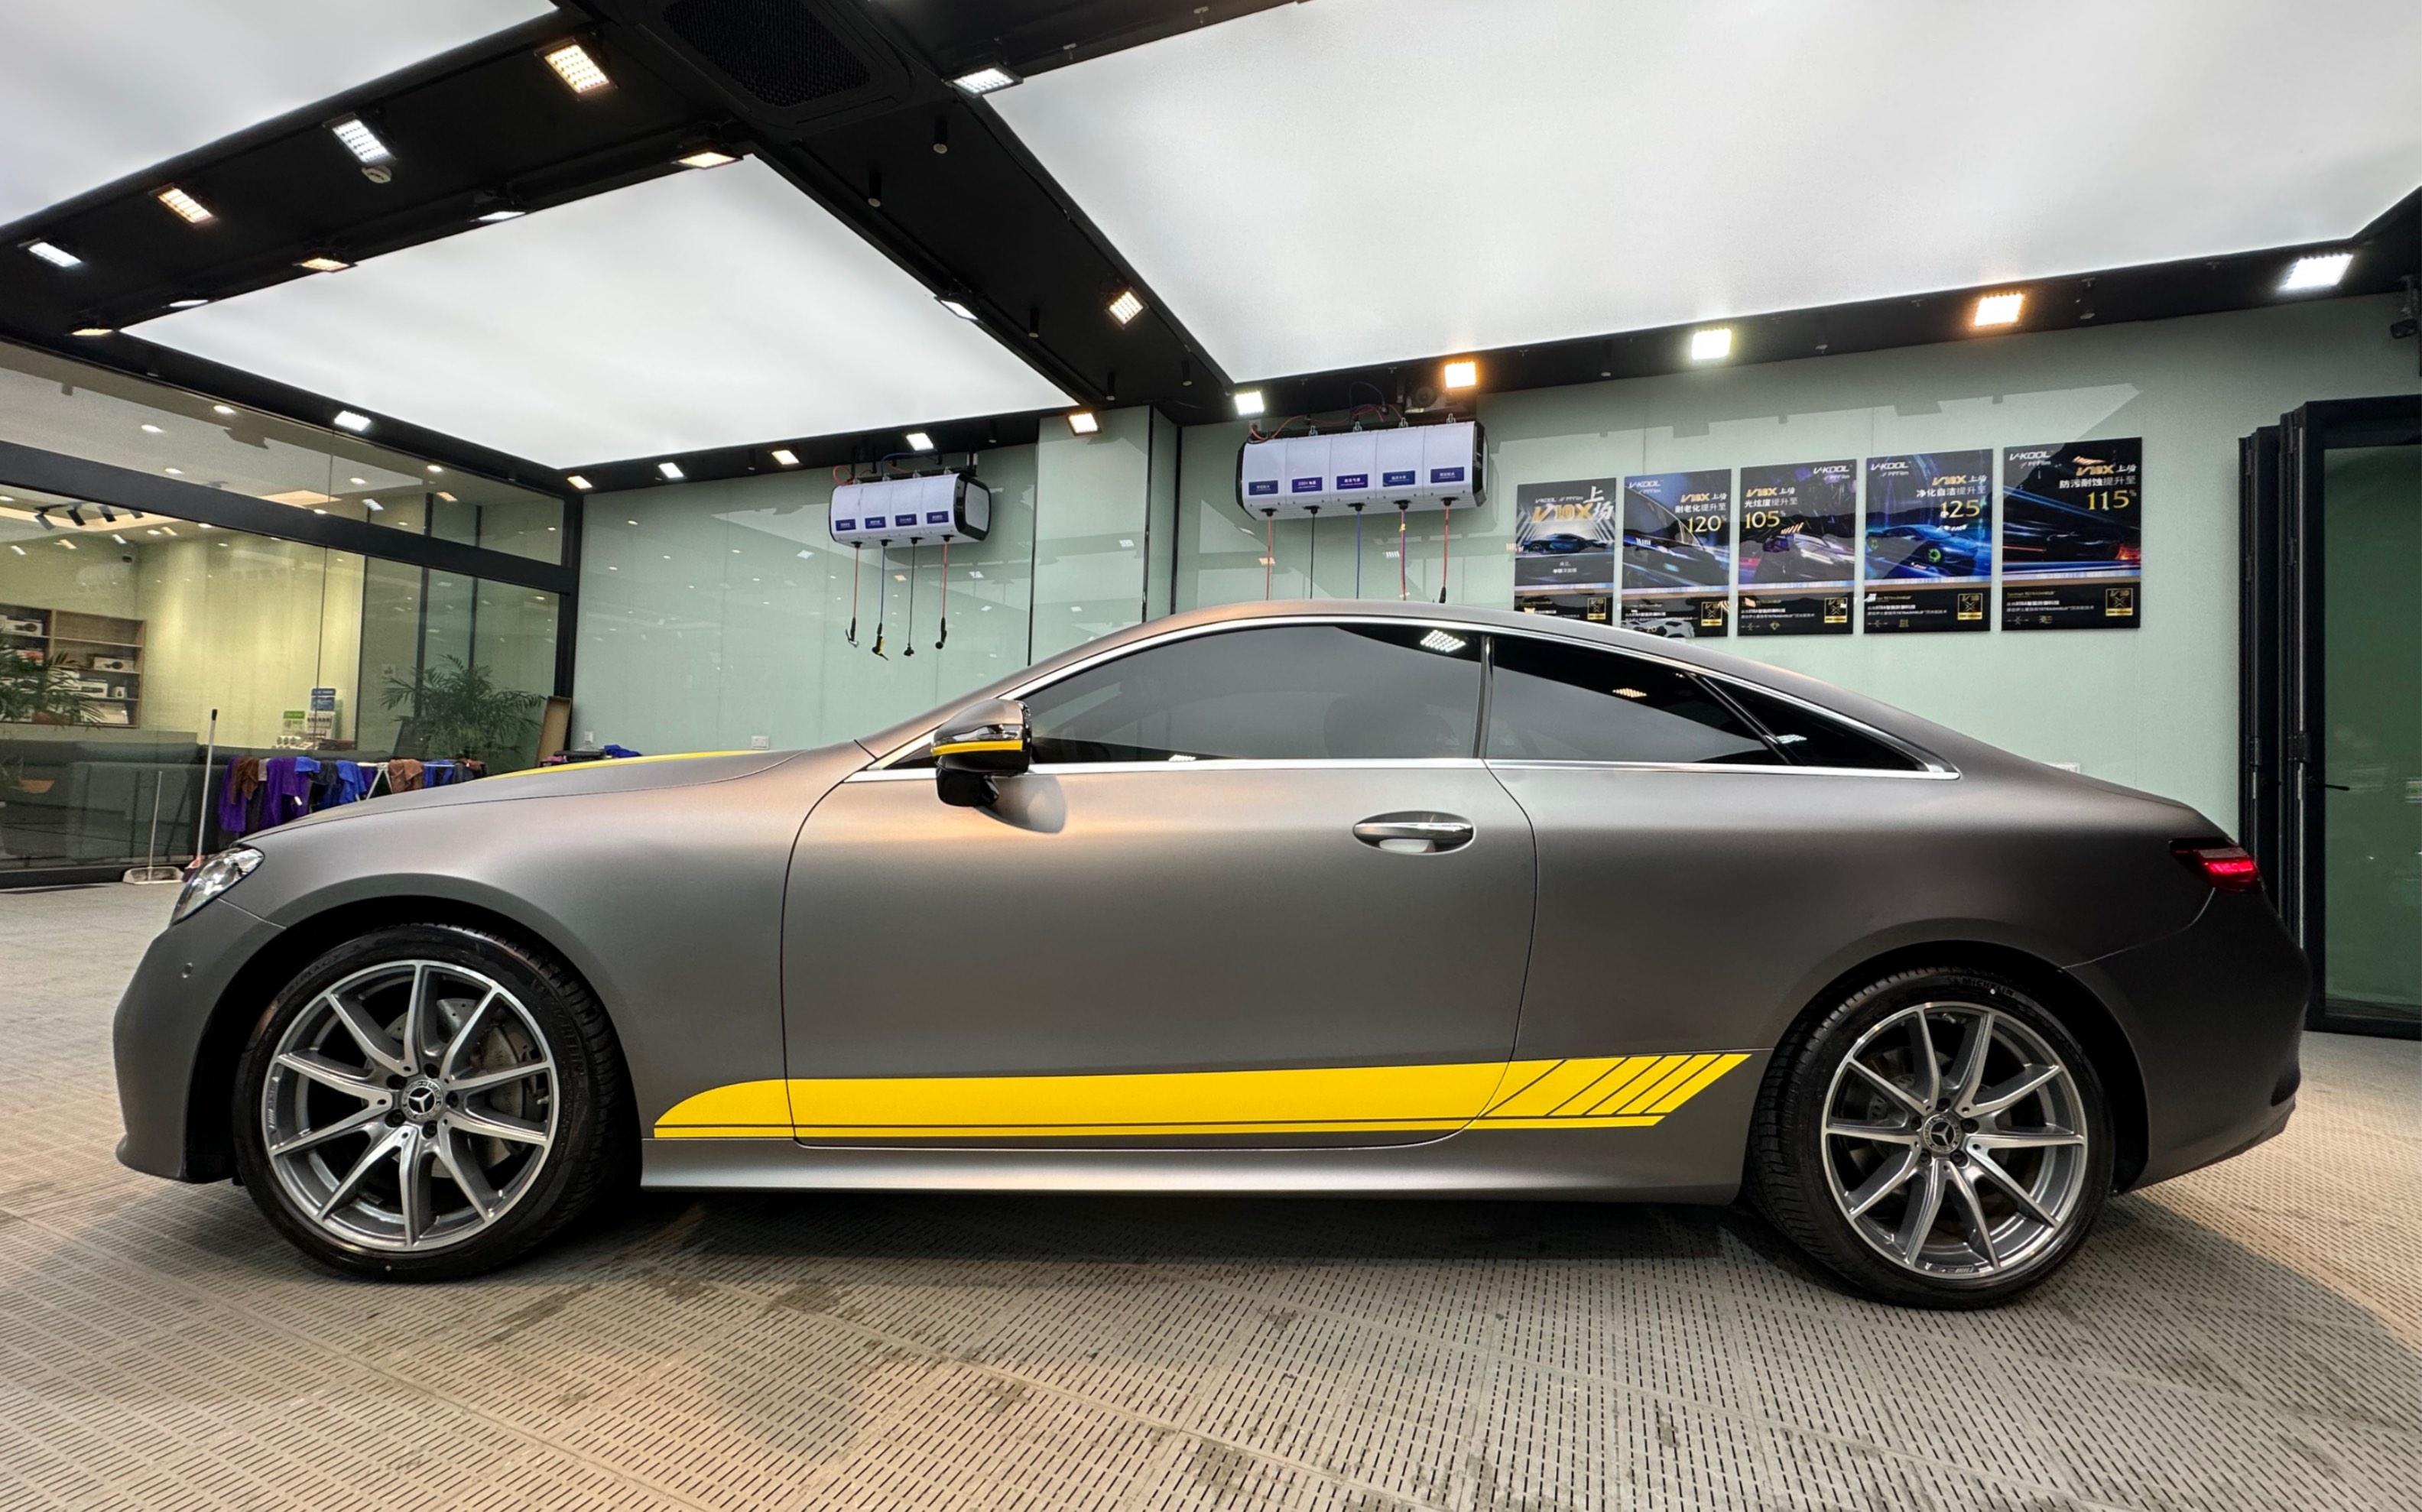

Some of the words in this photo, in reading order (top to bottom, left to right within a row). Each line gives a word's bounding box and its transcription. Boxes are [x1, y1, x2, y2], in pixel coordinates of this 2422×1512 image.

[2008, 451, 2051, 460] V-KOOL
[1813, 466, 1850, 474] V-KOOL
[1871, 462, 1908, 470] V-KOOL
[1628, 480, 1661, 488] V-KOOL
[2059, 475, 2136, 488] 防污耐蚀提升至
[1916, 485, 1987, 498] 净化自洁提升至
[1675, 503, 1727, 514] 耐老化提升至
